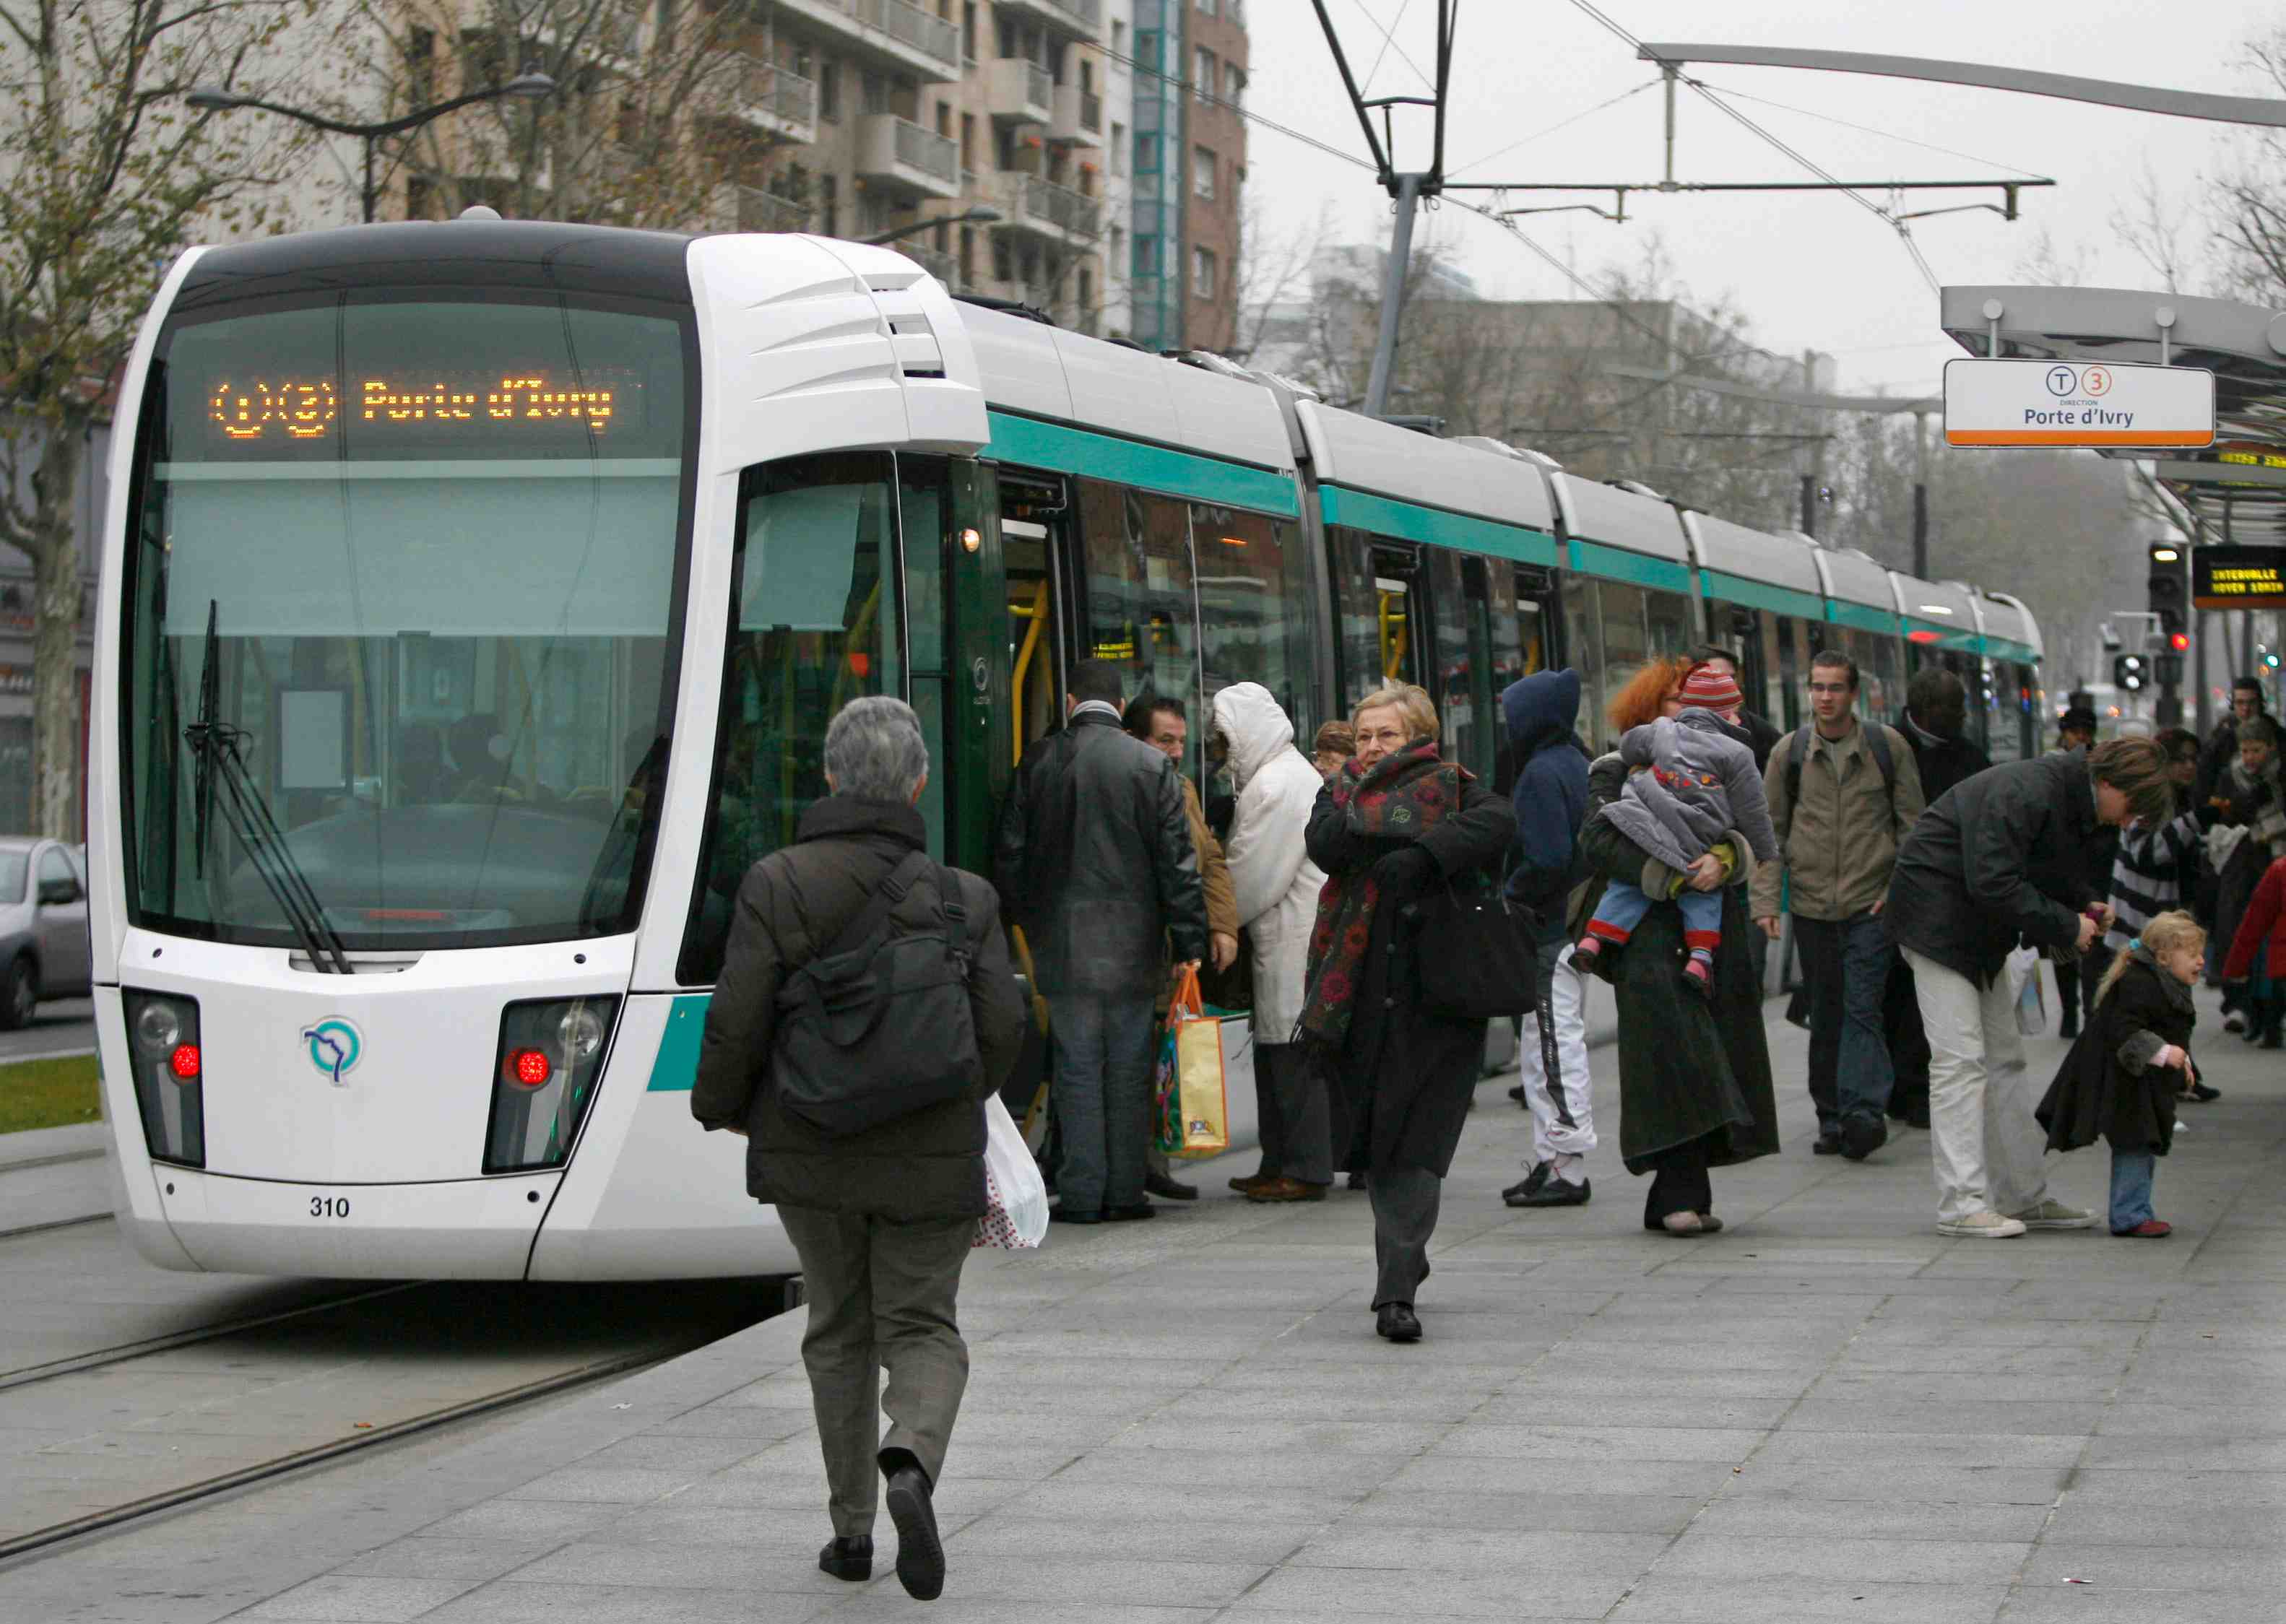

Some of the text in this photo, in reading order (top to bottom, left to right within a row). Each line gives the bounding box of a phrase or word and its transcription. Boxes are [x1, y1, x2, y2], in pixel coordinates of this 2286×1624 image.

[2025, 408, 2134, 428] Porte d'Ivry
[2212, 568, 2277, 581] INTERVALLE
[309, 1196, 350, 1218] 310
